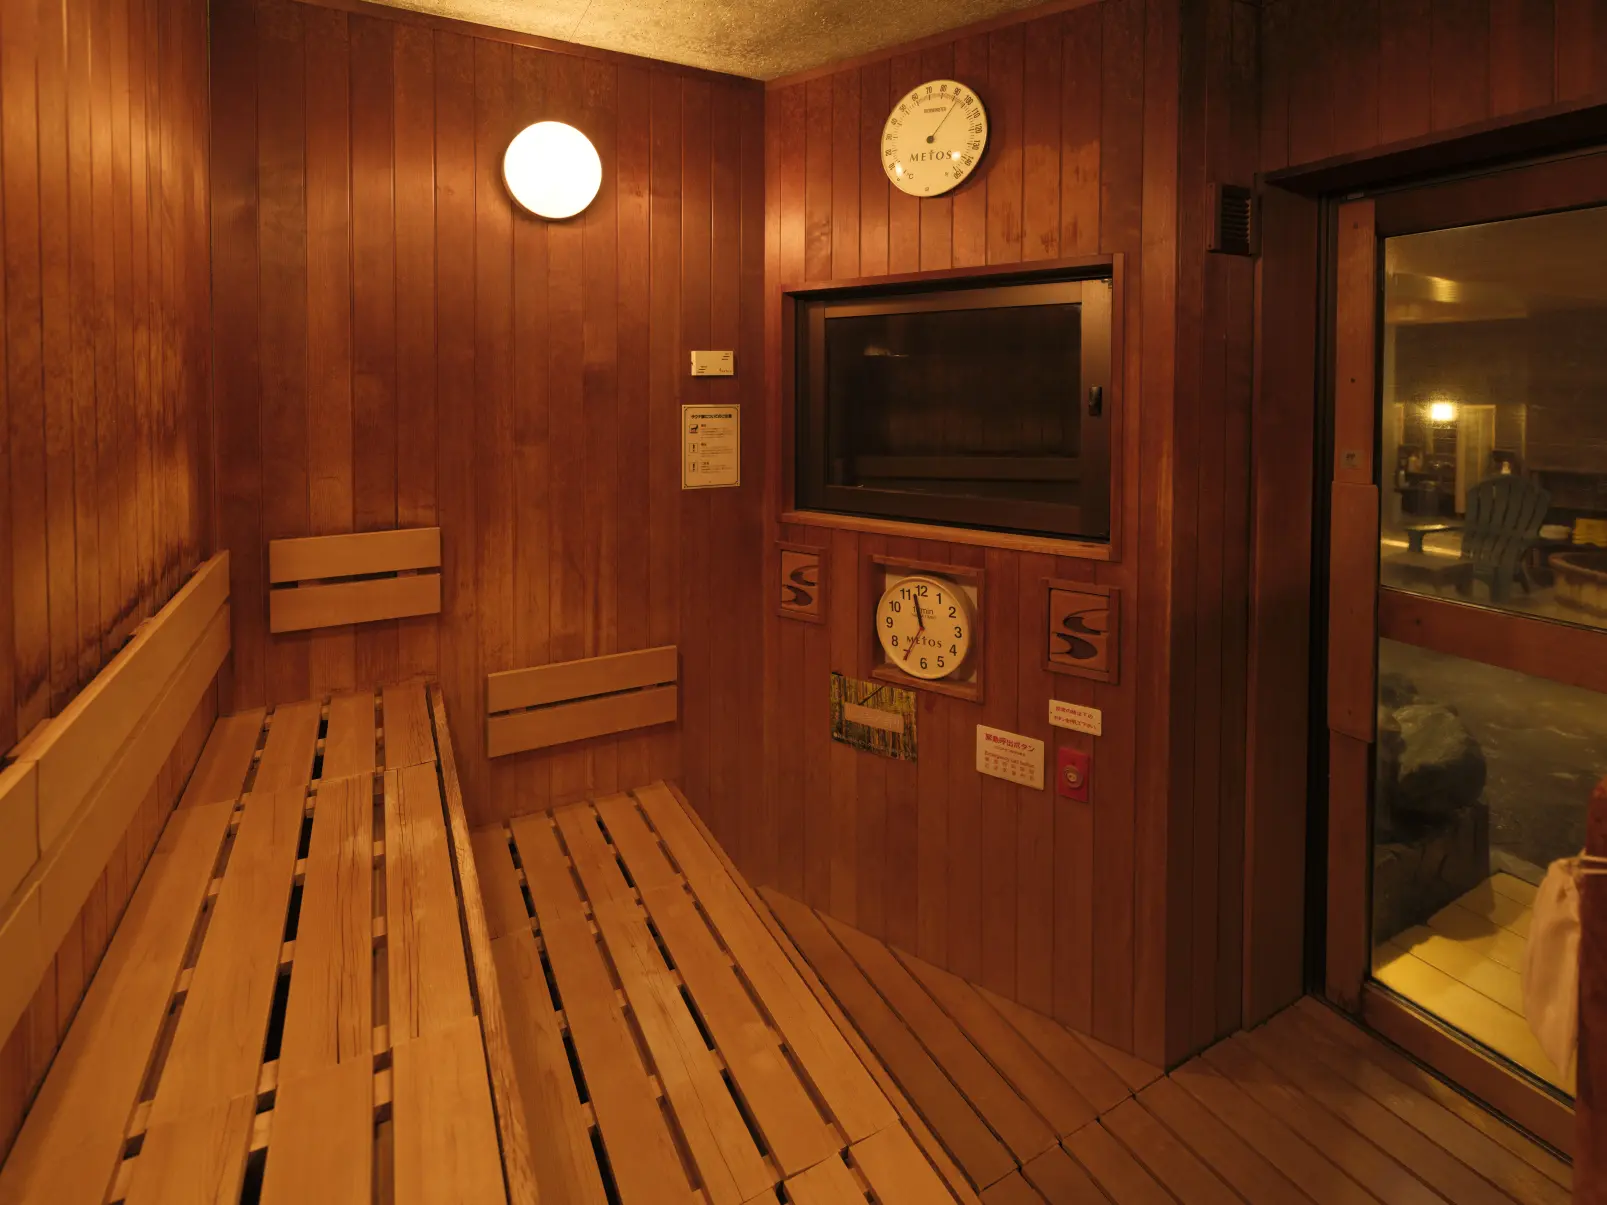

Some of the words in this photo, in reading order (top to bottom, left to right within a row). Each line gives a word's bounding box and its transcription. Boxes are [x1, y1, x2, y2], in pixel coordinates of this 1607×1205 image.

[926, 86, 932, 94] 70
[964, 95, 973, 105] 100
[971, 107, 980, 118] 110
[972, 140, 980, 150] 130
[910, 150, 952, 162] METOS
[965, 155, 974, 166] 140
[900, 588, 910, 600] 11
[915, 585, 928, 597] 12
[936, 593, 941, 604] 1
[889, 601, 901, 612] 10
[948, 607, 956, 618] 2
[886, 617, 893, 628] 9
[954, 627, 962, 638] 3
[892, 635, 898, 646] 8
[949, 645, 957, 656] 4
[920, 658, 927, 669] 6
[937, 656, 944, 667] 5
